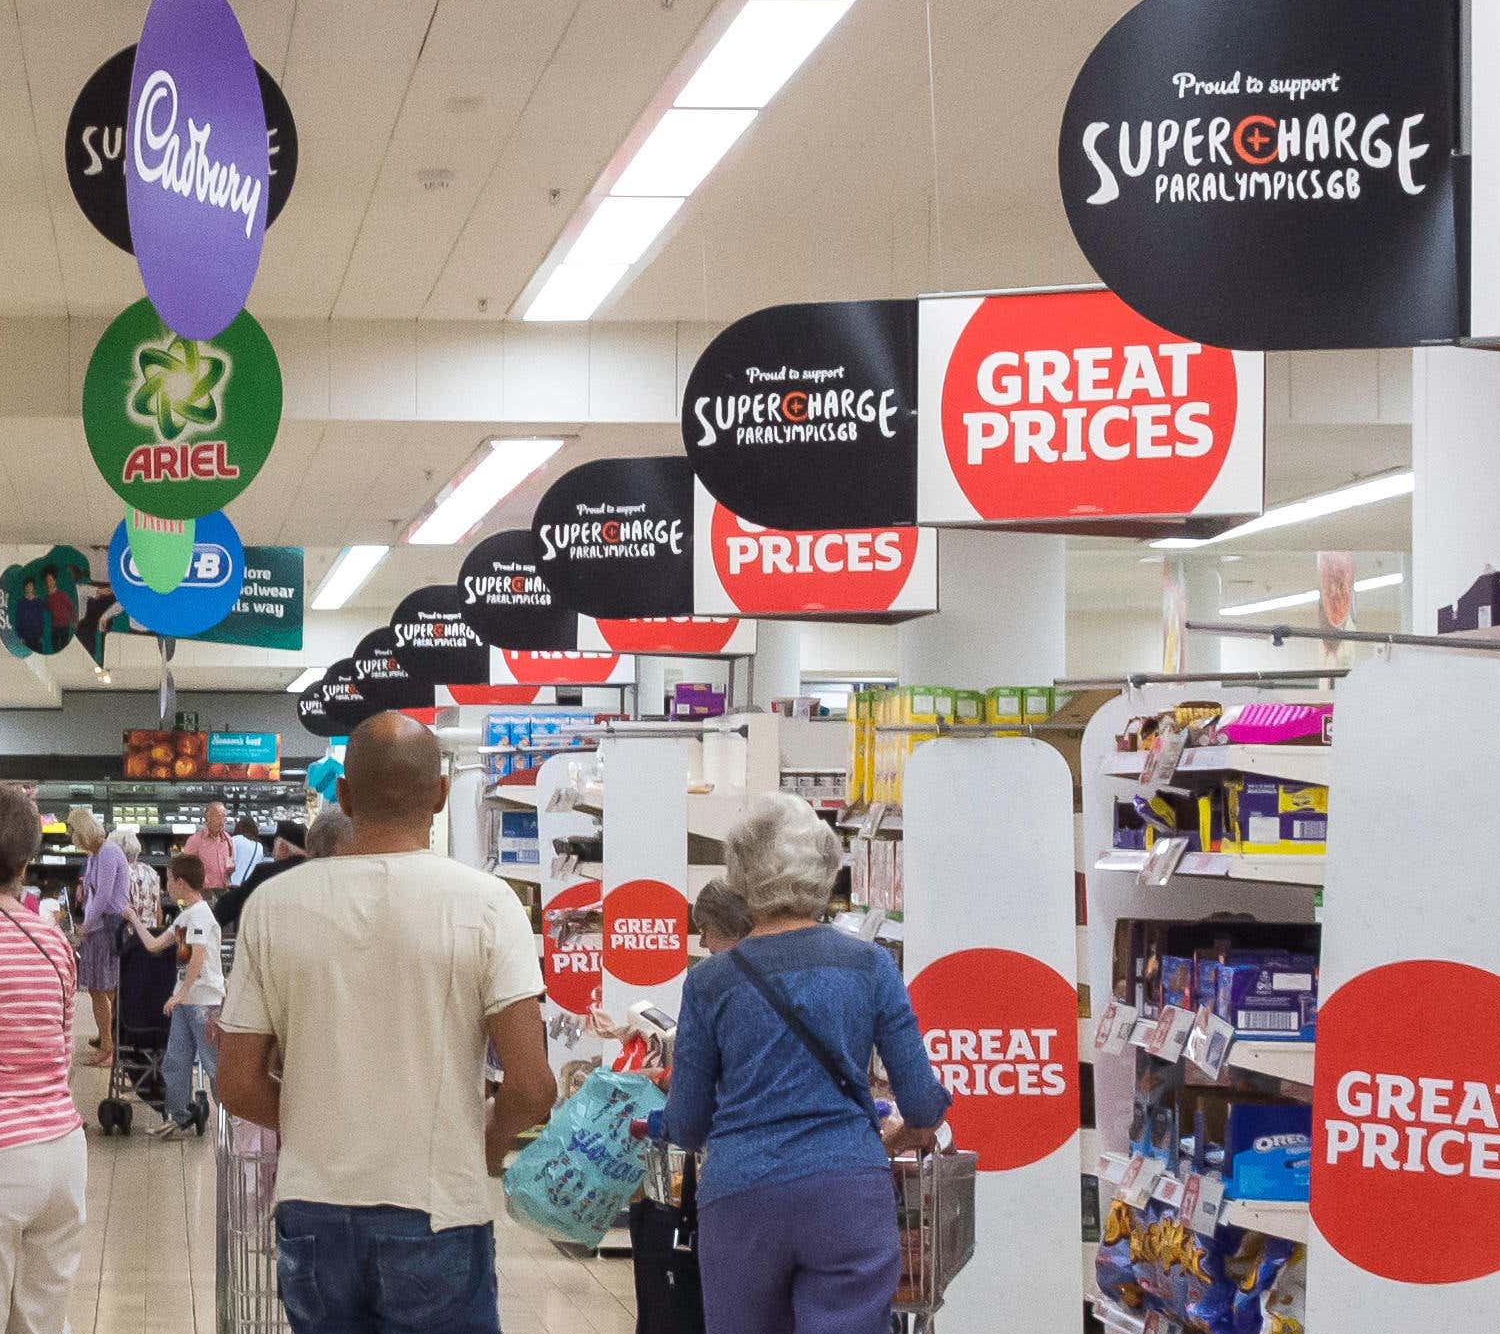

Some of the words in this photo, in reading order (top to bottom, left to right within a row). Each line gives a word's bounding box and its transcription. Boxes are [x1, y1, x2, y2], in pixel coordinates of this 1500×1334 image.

[1172, 72, 1241, 99] Proud
[1245, 76, 1263, 98] to
[1268, 72, 1340, 101] support
[133, 69, 262, 239] Cadbury
[1082, 111, 1431, 206] SUPERCHARGE
[746, 366, 785, 383] Proud
[788, 370, 800, 383] to
[801, 366, 845, 384] support
[976, 343, 1202, 405] GREAT
[694, 389, 899, 448] SUPERCHARGE
[963, 402, 1214, 465] PRICES
[122, 443, 240, 483] ARIEL
[576, 503, 604, 516] Proud
[539, 518, 685, 561] SUPERCHARGE
[726, 530, 903, 575] PRICES
[609, 932, 682, 951] PRICES
[612, 919, 676, 937] GREAT
[923, 1028, 1057, 1065] GREAT
[1254, 1133, 1308, 1154] OREO
